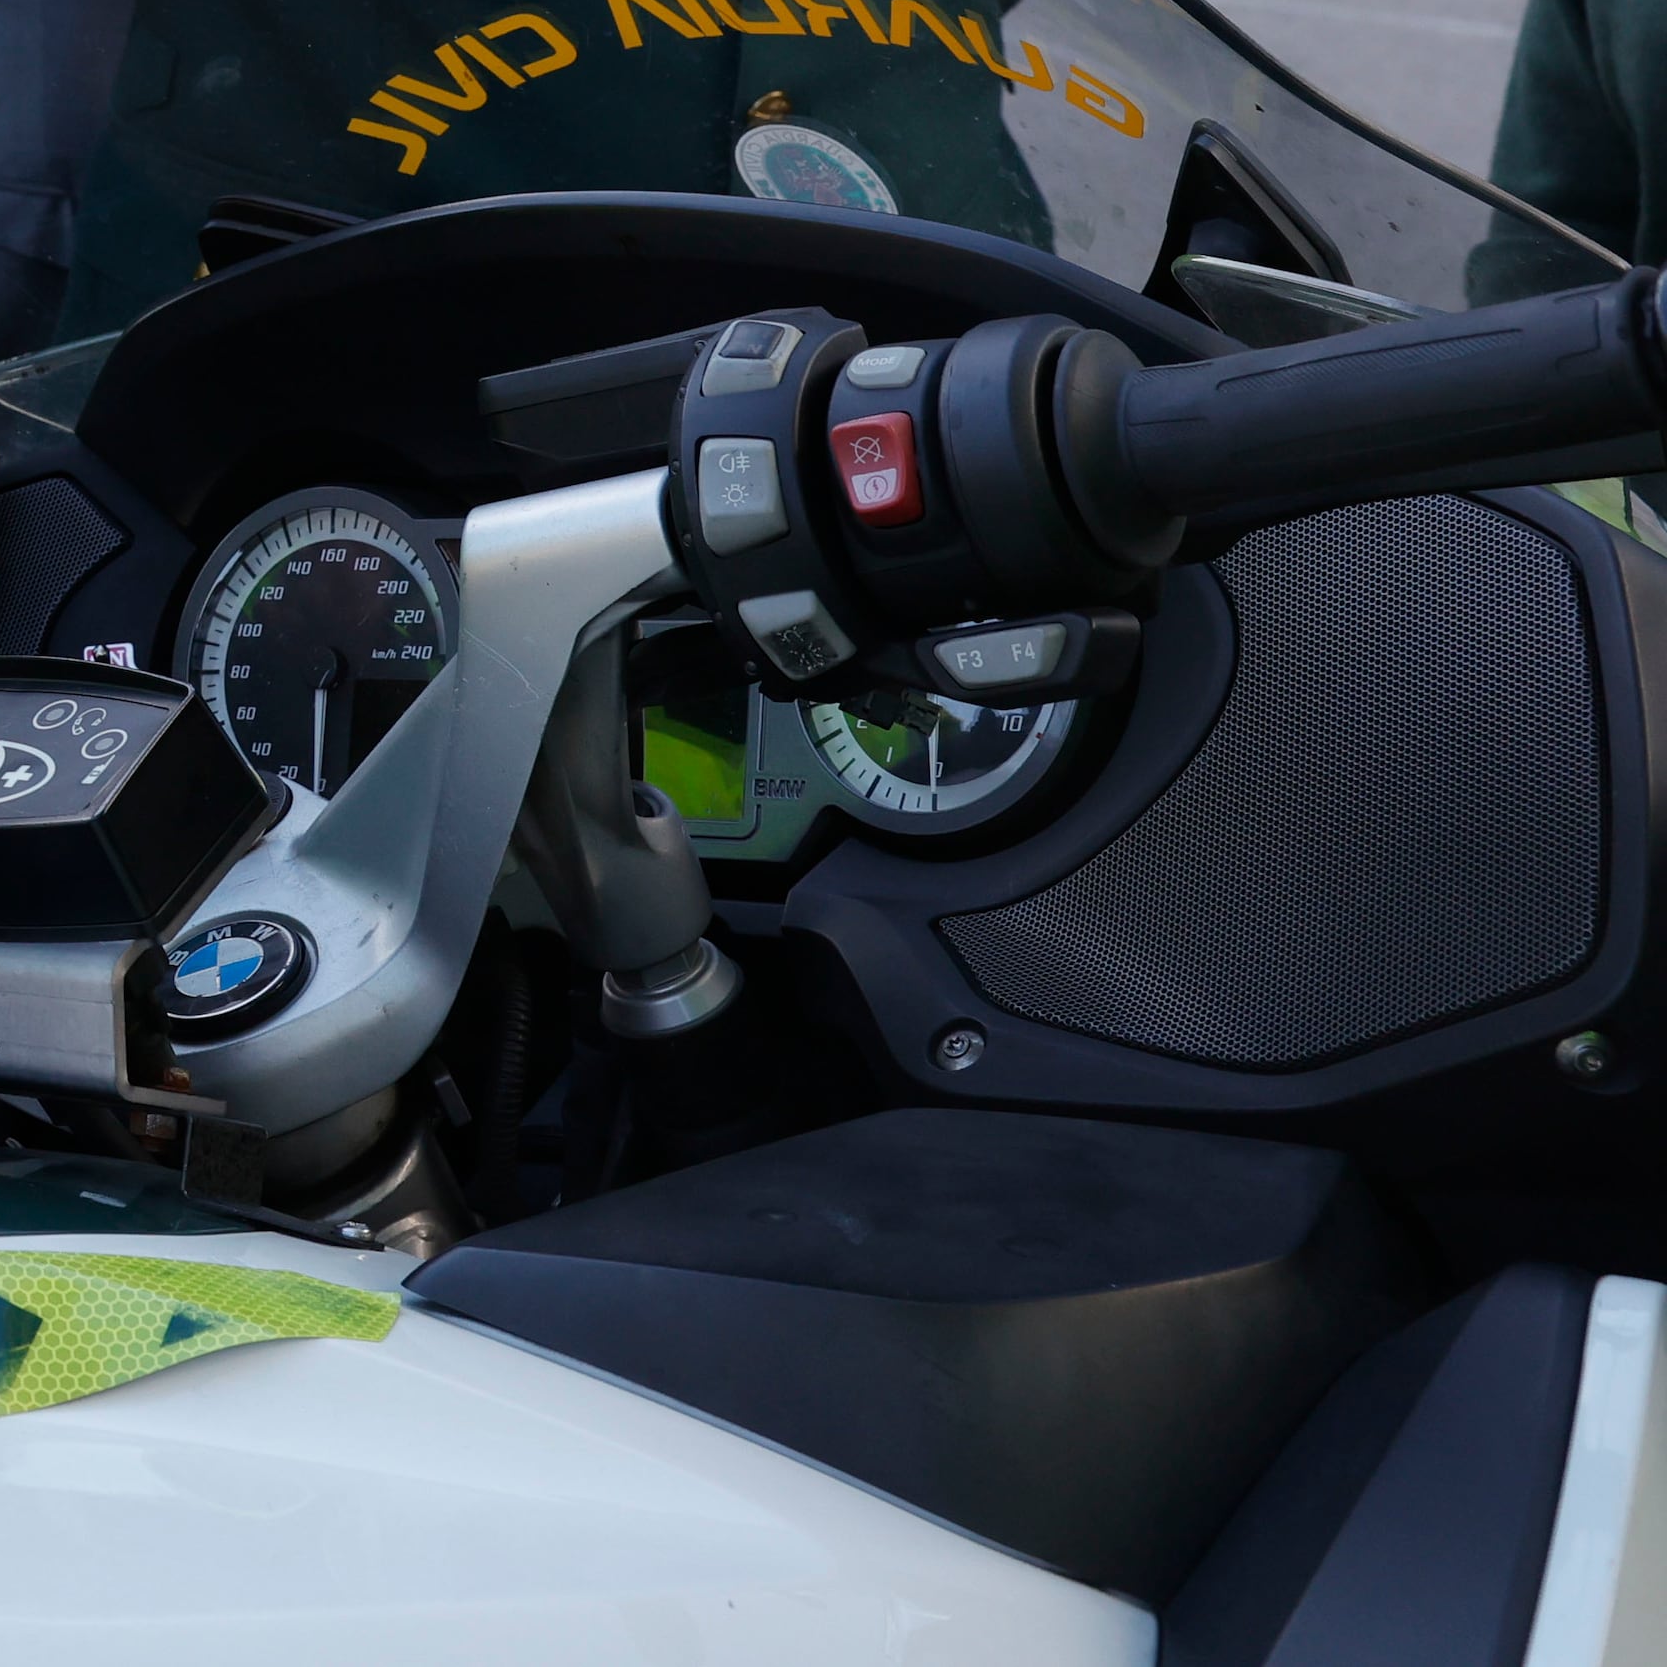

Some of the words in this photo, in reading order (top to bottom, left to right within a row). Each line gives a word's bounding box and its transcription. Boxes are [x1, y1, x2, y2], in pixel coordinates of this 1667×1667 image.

[856, 355, 898, 367] MODE
[320, 548, 347, 563] 160
[287, 561, 312, 575] 140
[354, 557, 381, 571] 180
[260, 586, 284, 600] 120
[377, 580, 409, 594] 200
[394, 609, 425, 624] 220
[238, 623, 263, 638] 100
[371, 648, 397, 660] km/h
[401, 645, 433, 660] 240
[956, 650, 984, 671] F3
[1011, 641, 1036, 663] F4
[230, 665, 251, 679] 80
[236, 706, 257, 721] 60
[1002, 714, 1024, 733] 10
[251, 742, 272, 757] 40
[278, 765, 299, 780] 20
[752, 778, 807, 801] BMW
[168, 924, 279, 966] BMW
